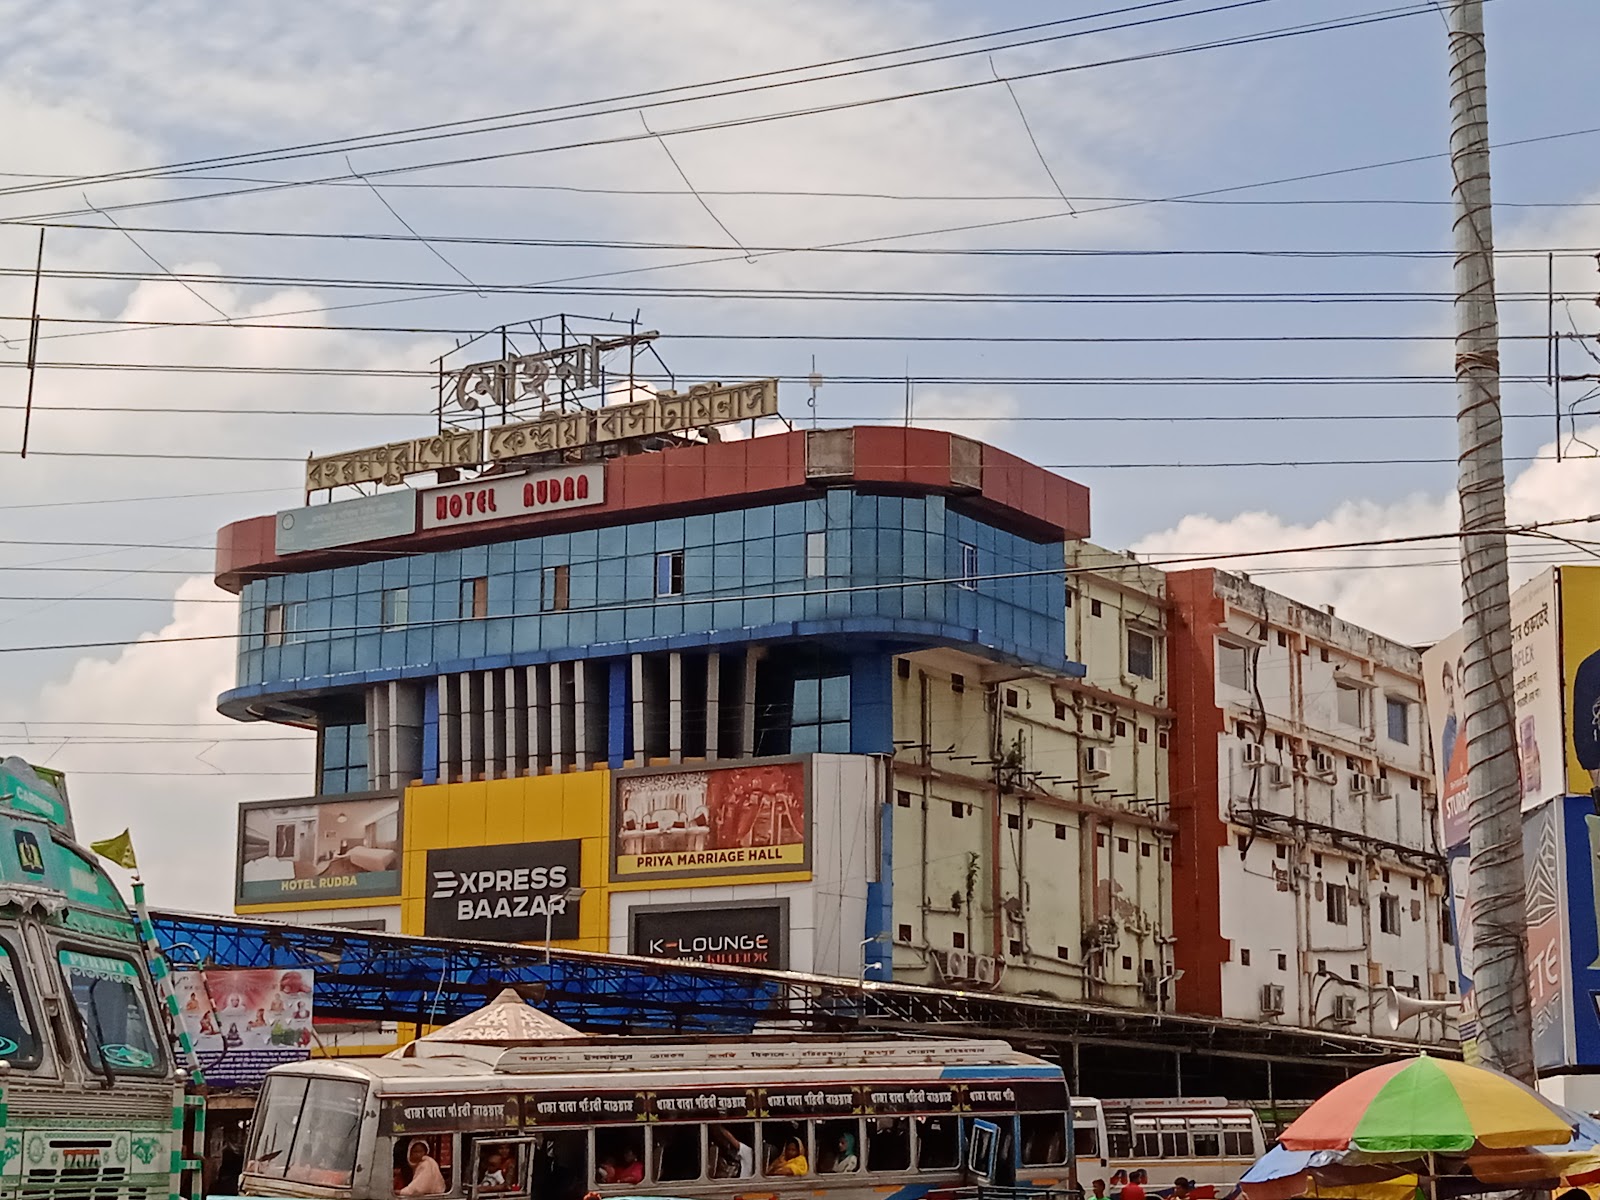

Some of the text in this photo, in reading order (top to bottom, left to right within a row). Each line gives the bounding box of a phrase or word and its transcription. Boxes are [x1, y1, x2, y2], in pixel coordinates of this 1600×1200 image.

[598, 400, 653, 438] বাস
[436, 474, 589, 520] HOTEL RUDRA
[636, 846, 784, 869] PRIYA MARRIAGE HALL
[281, 874, 358, 892] HOTEL RUDRA
[433, 864, 568, 898] EXPRESS
[457, 894, 567, 922] BAAZAR
[649, 934, 769, 954] K-LOUNGE
[676, 1097, 694, 1110] বাবা
[786, 1094, 804, 1106] বাবা
[888, 1092, 905, 1103] বাবা
[986, 1090, 1002, 1102] বাবা
[426, 1105, 446, 1119] বাবা
[557, 1100, 578, 1113] বাবা
